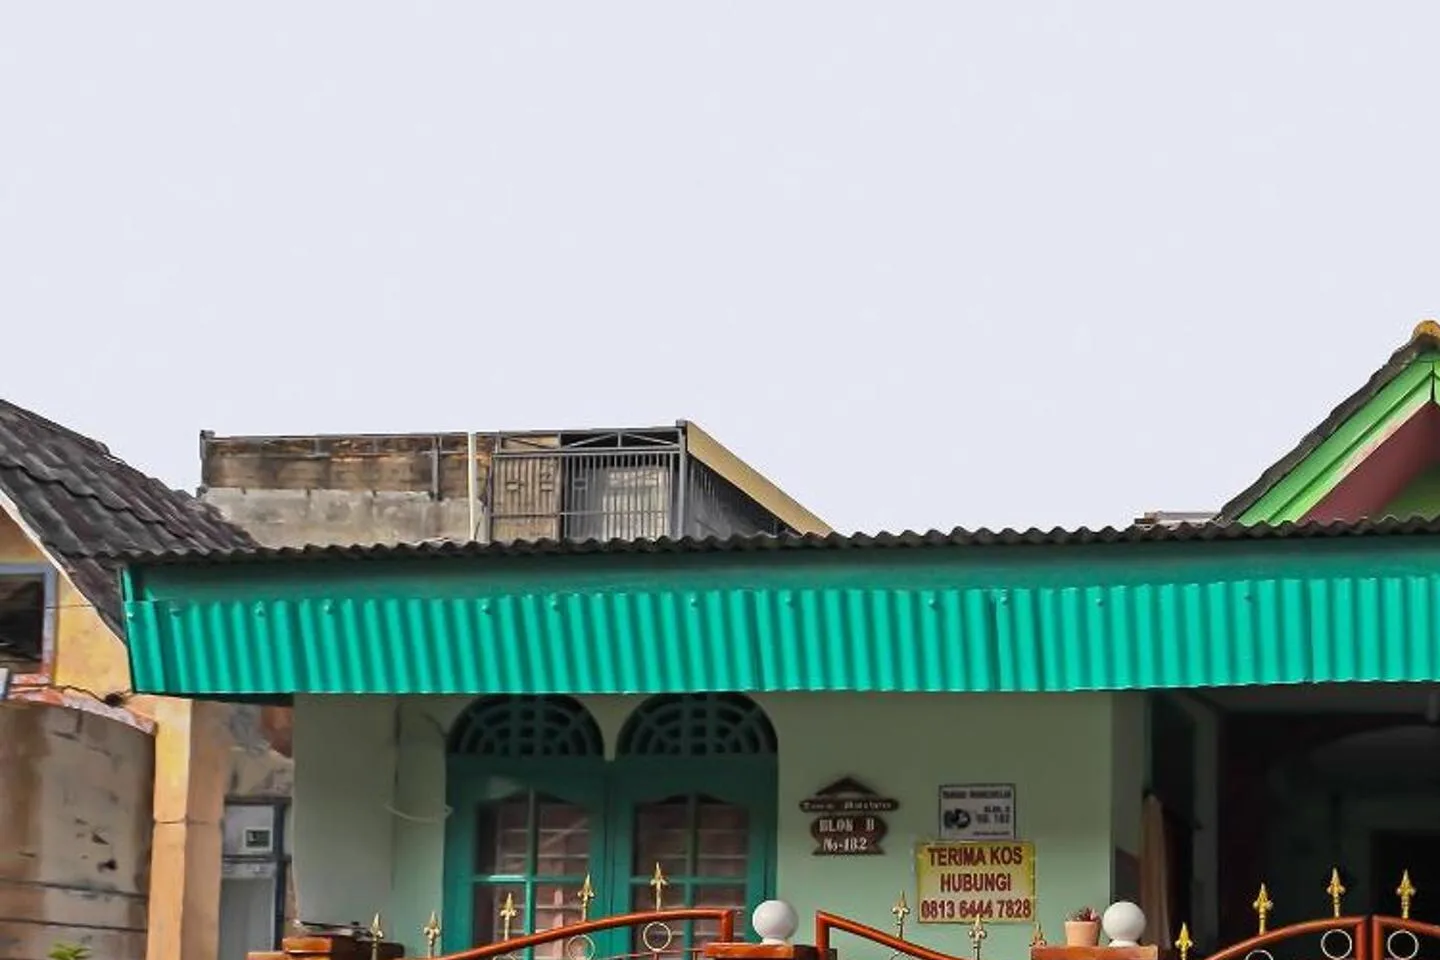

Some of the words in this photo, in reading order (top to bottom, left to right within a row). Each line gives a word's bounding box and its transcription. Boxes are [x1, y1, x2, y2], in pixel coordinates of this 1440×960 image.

[927, 846, 987, 867] TERIMA
[989, 845, 1023, 865] KOS
[940, 872, 1012, 893] HUBUNGI
[920, 899, 956, 919] 0813
[959, 899, 994, 919] 6444
[996, 898, 1032, 919] 7828
